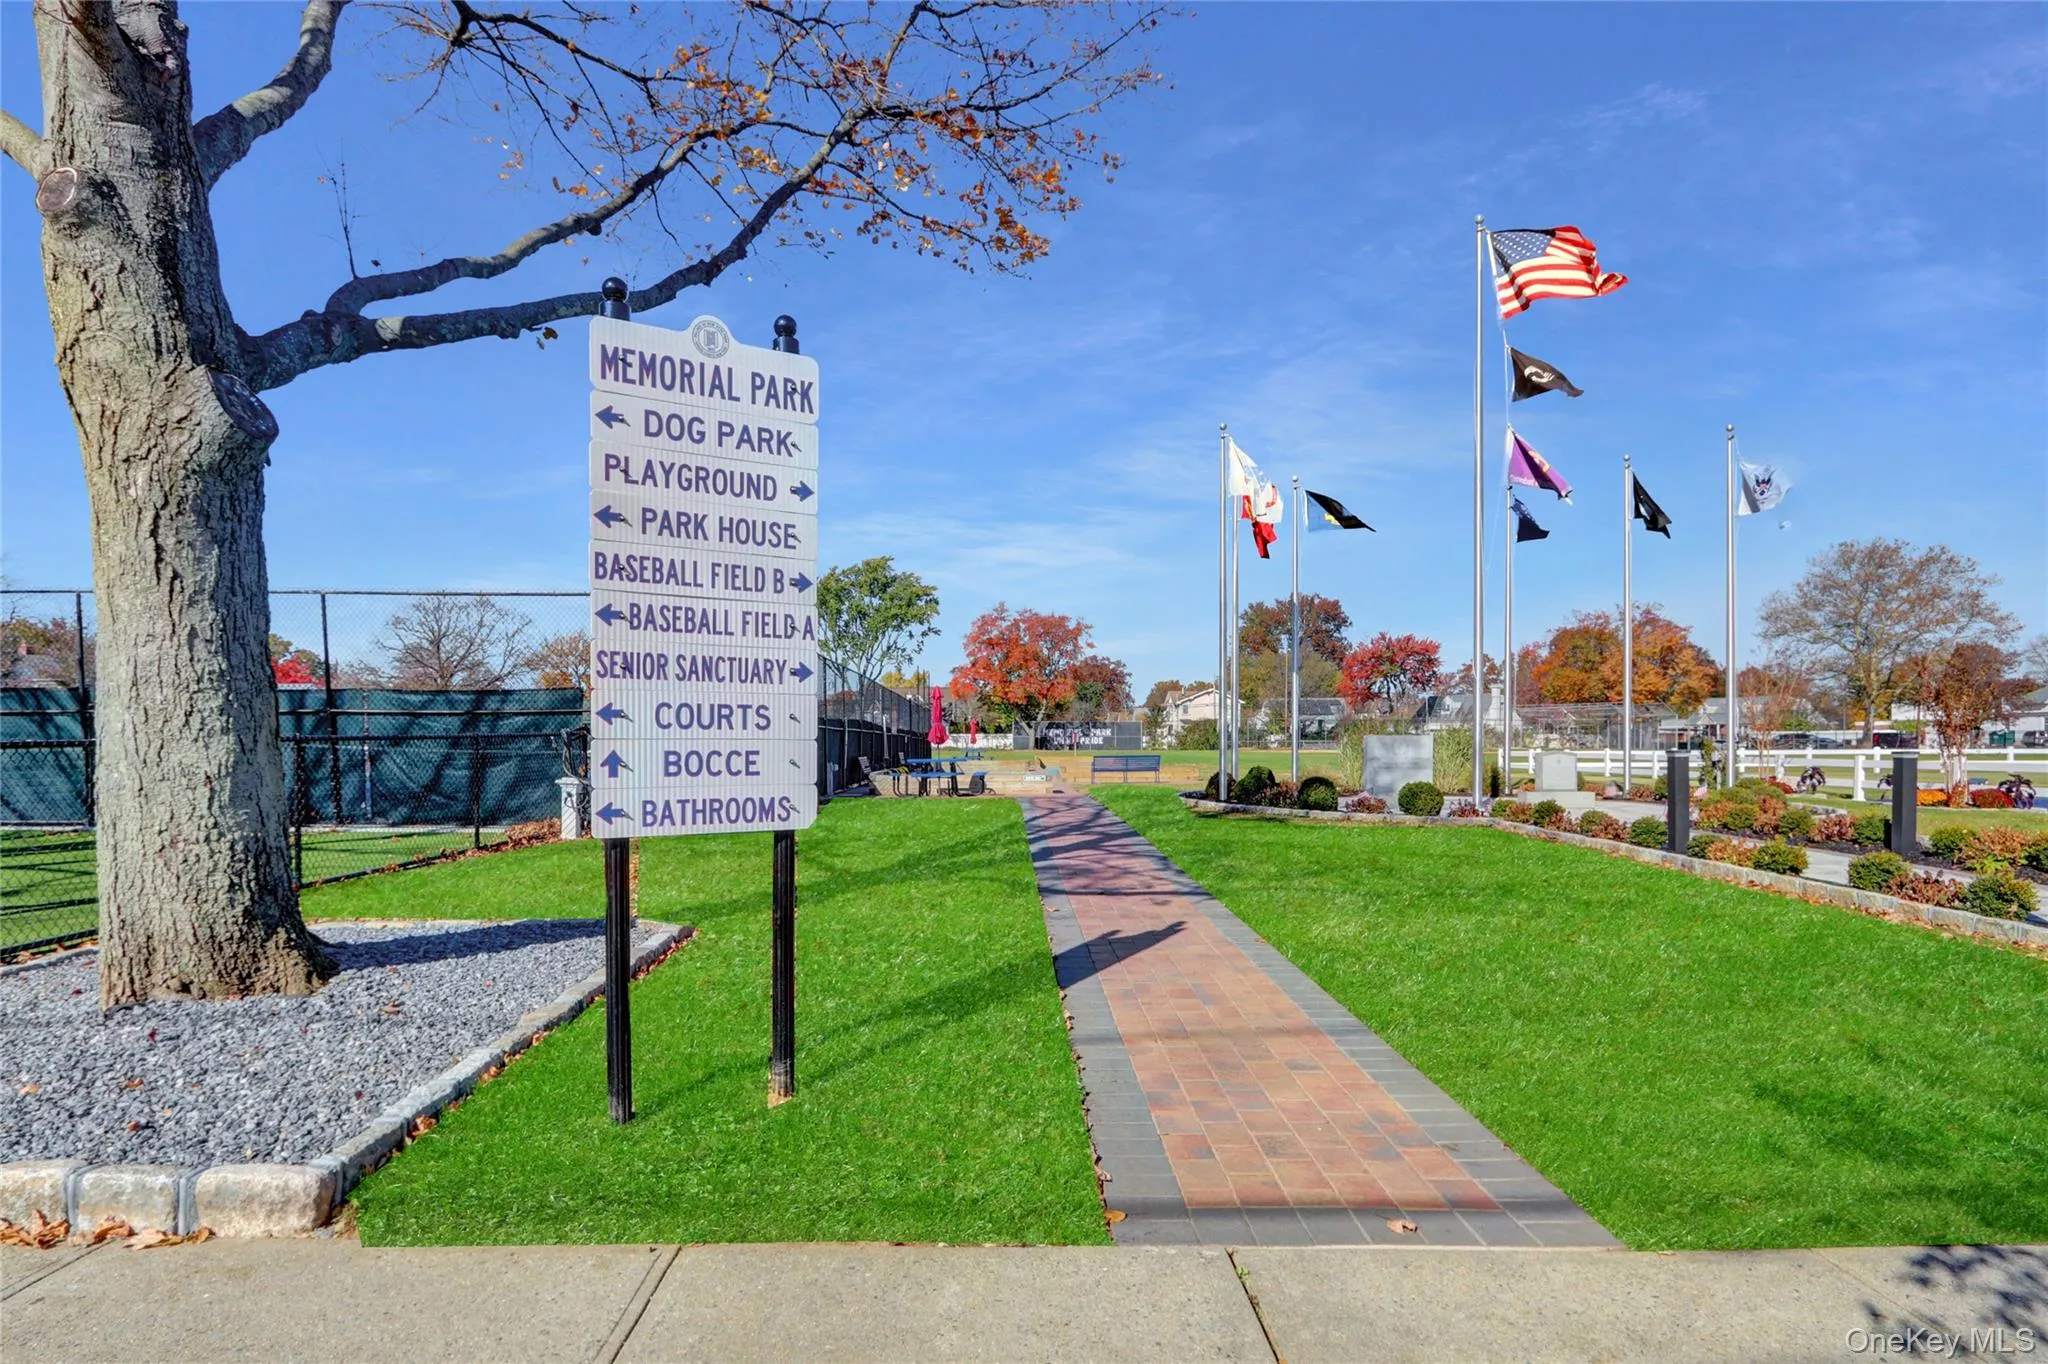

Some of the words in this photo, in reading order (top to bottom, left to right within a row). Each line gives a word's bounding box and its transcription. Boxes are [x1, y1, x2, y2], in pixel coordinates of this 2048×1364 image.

[600, 343, 741, 402] MEMORIAL
[751, 371, 814, 414] PARK
[643, 409, 706, 445] DOG
[717, 420, 794, 458] PARK
[604, 453, 777, 502] PLAYGROUND
[641, 506, 710, 542] PARK
[718, 515, 797, 550] HOUSE
[594, 551, 704, 588] BASEBALL
[711, 562, 766, 593] FIELD
[773, 568, 785, 594] B
[628, 602, 735, 637] BASEBALL
[741, 610, 796, 640] FIELD
[802, 615, 815, 641] A
[595, 649, 669, 681] SENIOR
[674, 653, 788, 685] SANCTUARY
[654, 701, 772, 731] COURTS
[663, 749, 761, 778] BOCCE
[641, 795, 791, 828] BATHROOMS
